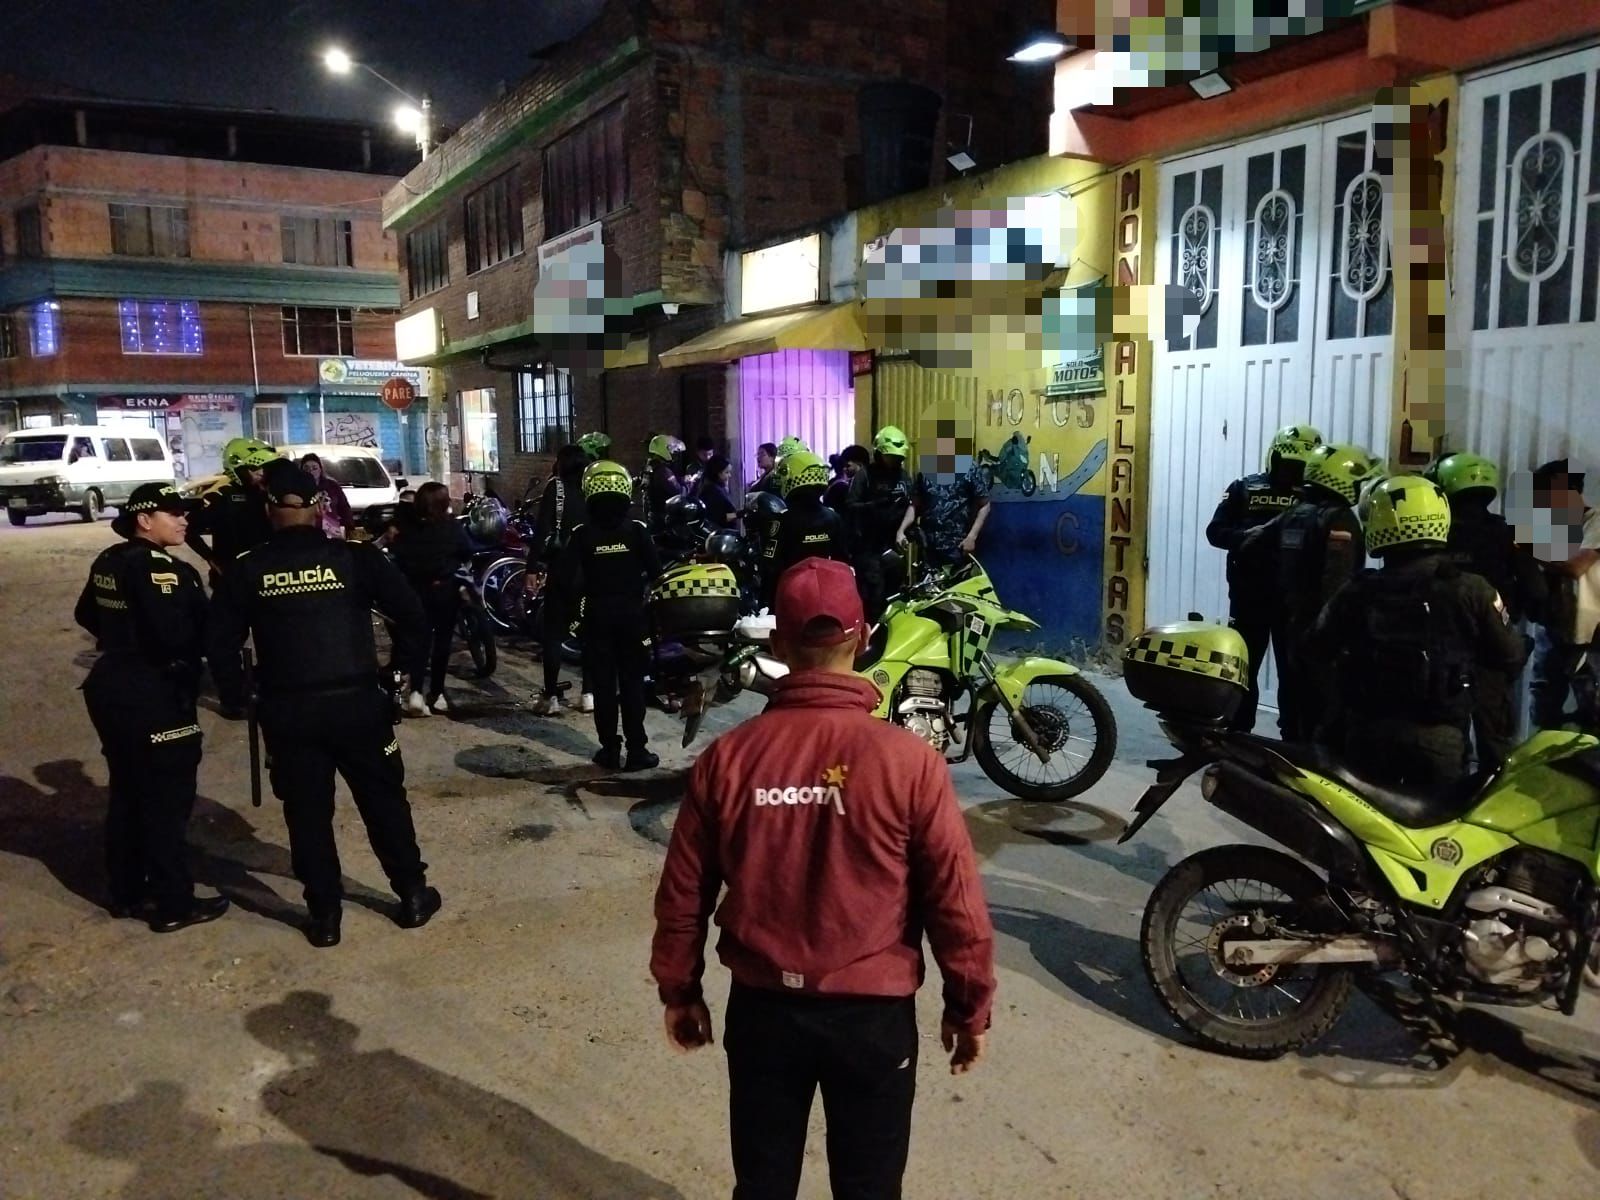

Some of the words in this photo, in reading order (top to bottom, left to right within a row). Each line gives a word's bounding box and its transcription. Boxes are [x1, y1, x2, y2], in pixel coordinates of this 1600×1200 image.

[1053, 366, 1098, 383] MOTOS
[384, 387, 412, 400] PARE
[126, 398, 170, 407] EKNA
[986, 389, 1096, 428] MOTOS
[1107, 168, 1141, 645] MONALLANTAS
[1250, 495, 1299, 506] POLICÍA
[1399, 512, 1446, 524] POLICÍA
[804, 532, 829, 541] POLICÍA
[595, 543, 627, 552] POLICÍA
[263, 565, 337, 587] POLICÍA
